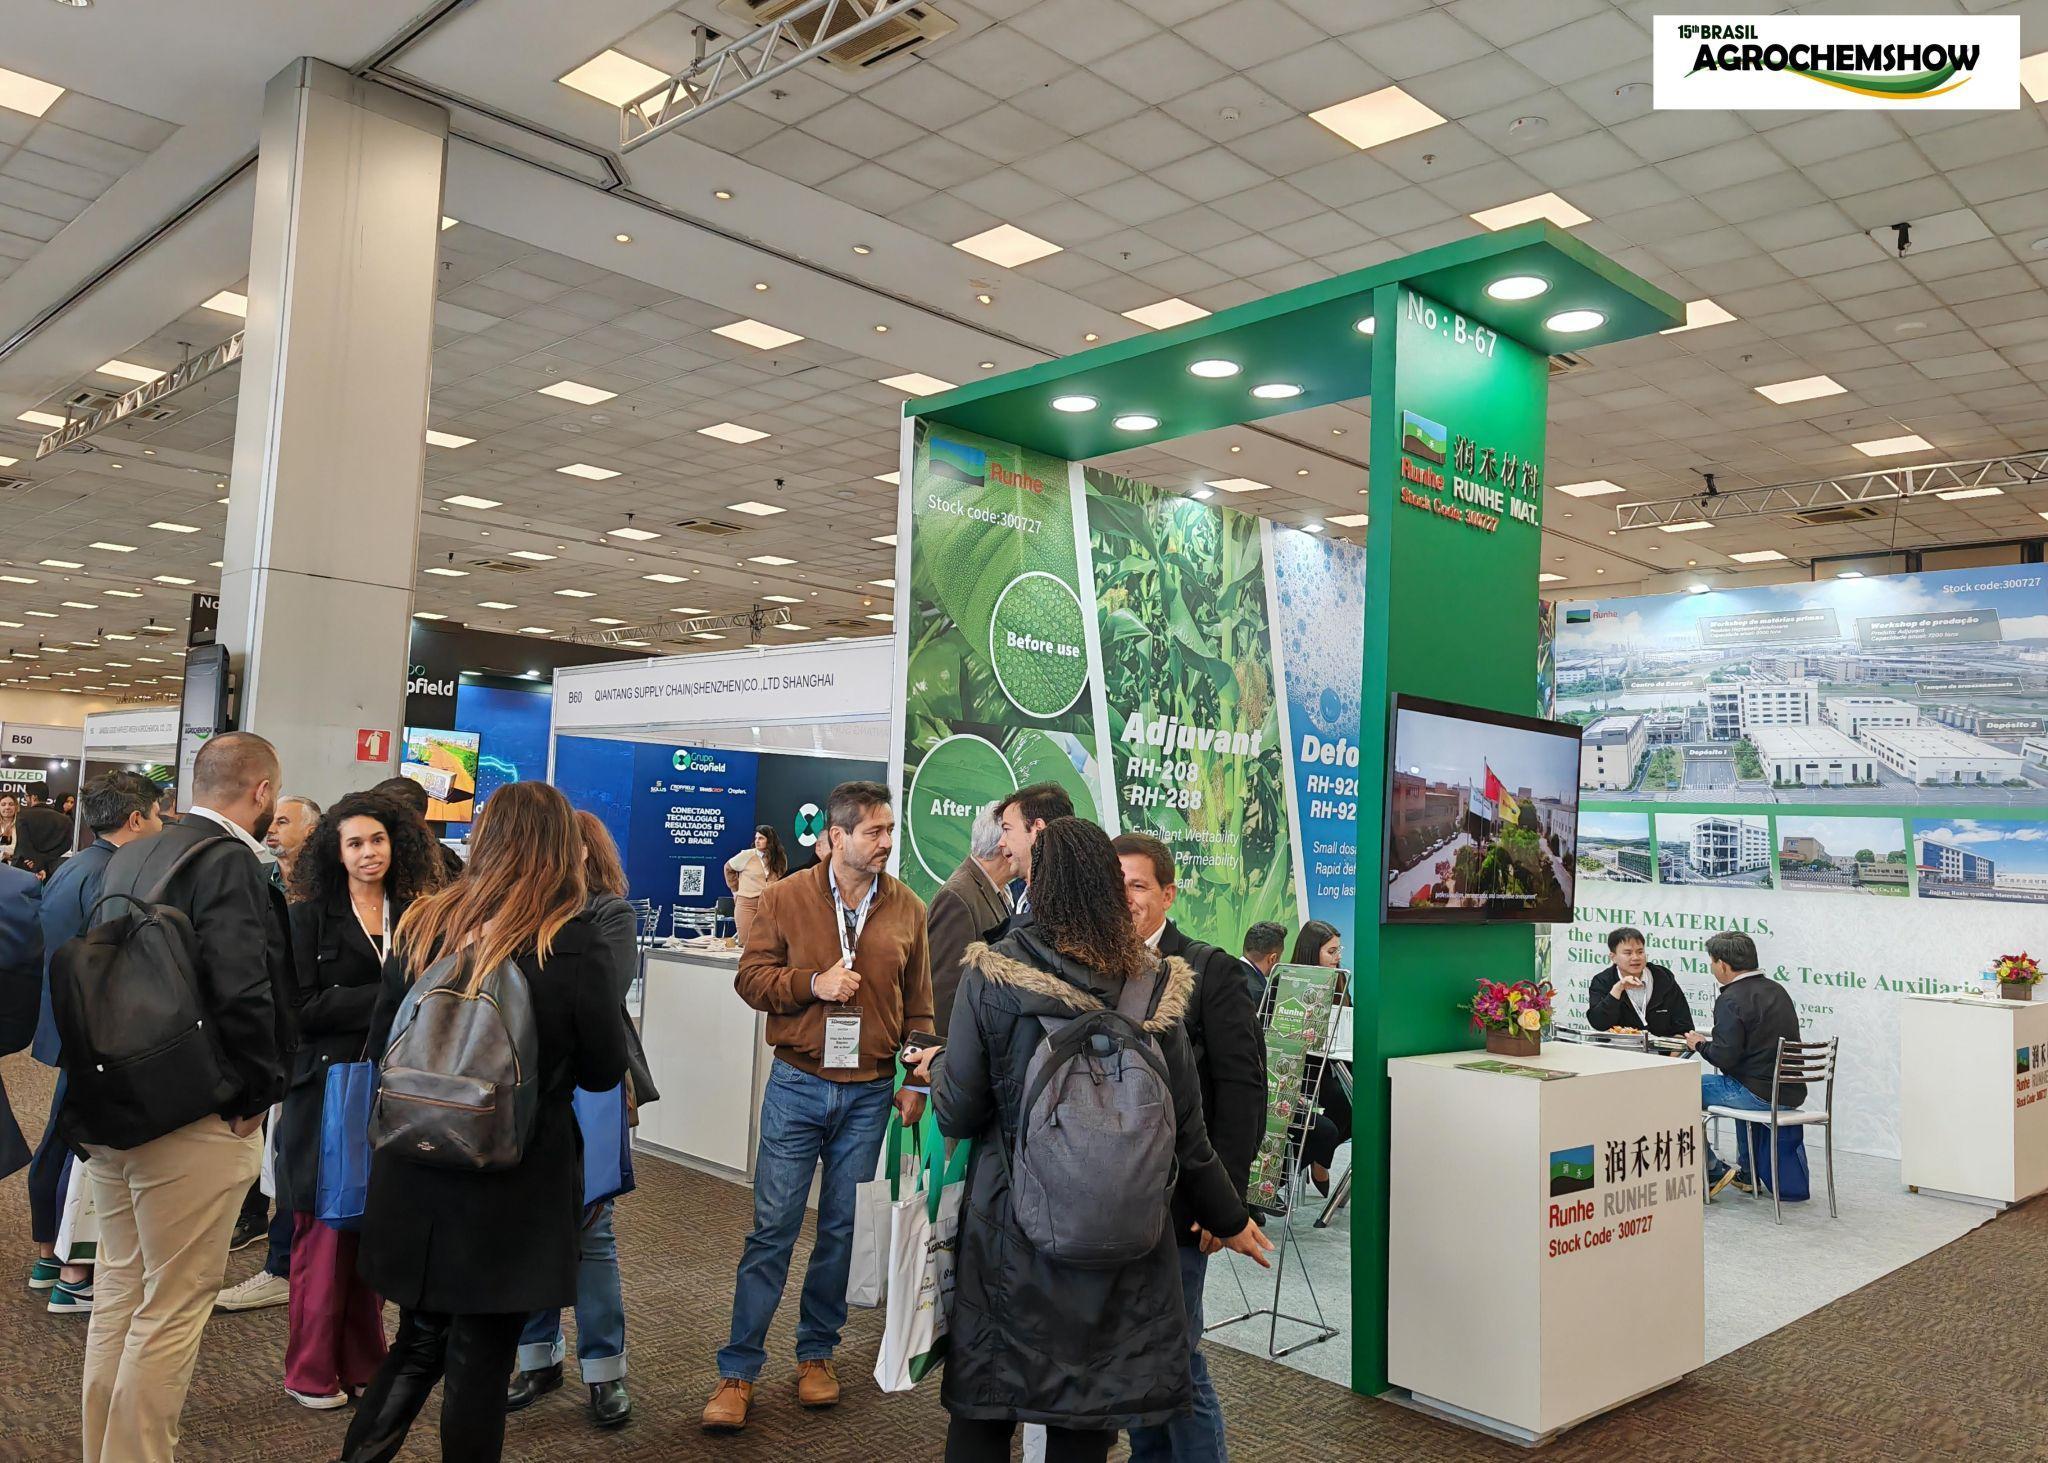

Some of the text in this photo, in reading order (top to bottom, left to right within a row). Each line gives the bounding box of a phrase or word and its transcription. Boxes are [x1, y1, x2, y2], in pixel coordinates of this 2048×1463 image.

[1455, 314, 1497, 358] B-67
[1402, 457, 1444, 490] Runhe
[1454, 434, 1539, 498] 润禾材料
[990, 462, 1044, 494] Runhe
[928, 494, 965, 516] Stock
[1402, 487, 1431, 511] Stock
[1453, 476, 1539, 526] RUNHE MAT.
[1943, 583, 1972, 593] Stock
[1871, 621, 1917, 629] Workshop
[1007, 630, 1080, 658] Before use
[568, 691, 582, 704] B60
[594, 687, 633, 702] QIANTANG
[634, 685, 664, 699] SUPPLY
[783, 673, 834, 690] SHANGHAI
[1120, 711, 1263, 757] Adjuvant
[1986, 721, 2038, 731] Depósito 2
[12, 735, 32, 744] B50
[690, 761, 726, 773] Cropfield
[691, 752, 714, 763] Grupo
[1126, 756, 1199, 783] RH-208
[930, 798, 972, 817] After
[1130, 785, 1202, 810] RH-288
[666, 813, 718, 823] TECNOLOGIAS
[670, 806, 721, 816] CONECTANDO
[664, 821, 725, 831] RESULTADOS EM
[670, 829, 719, 838] CADA CANTO
[687, 837, 714, 845] BRASIL
[1184, 828, 1240, 848] Wettability
[1313, 840, 1338, 854] Small
[1174, 851, 1239, 870] Permeability
[1315, 861, 1342, 878] Rapid
[1317, 883, 1340, 900] Long
[1573, 906, 1774, 938] RUNHE MATERIALS,
[1568, 927, 1592, 942] the
[1567, 946, 1611, 966] Silico
[1773, 964, 1791, 983] &
[1797, 966, 1867, 989] Textile
[1800, 1004, 1834, 1015] years
[1604, 1125, 1696, 1184] 润禾材料
[1604, 1173, 1697, 1218] RUNHE MAT.
[1549, 1199, 1595, 1229] Runhe
[1548, 1233, 1581, 1259] Stock
[1618, 1214, 1654, 1240] 300727
